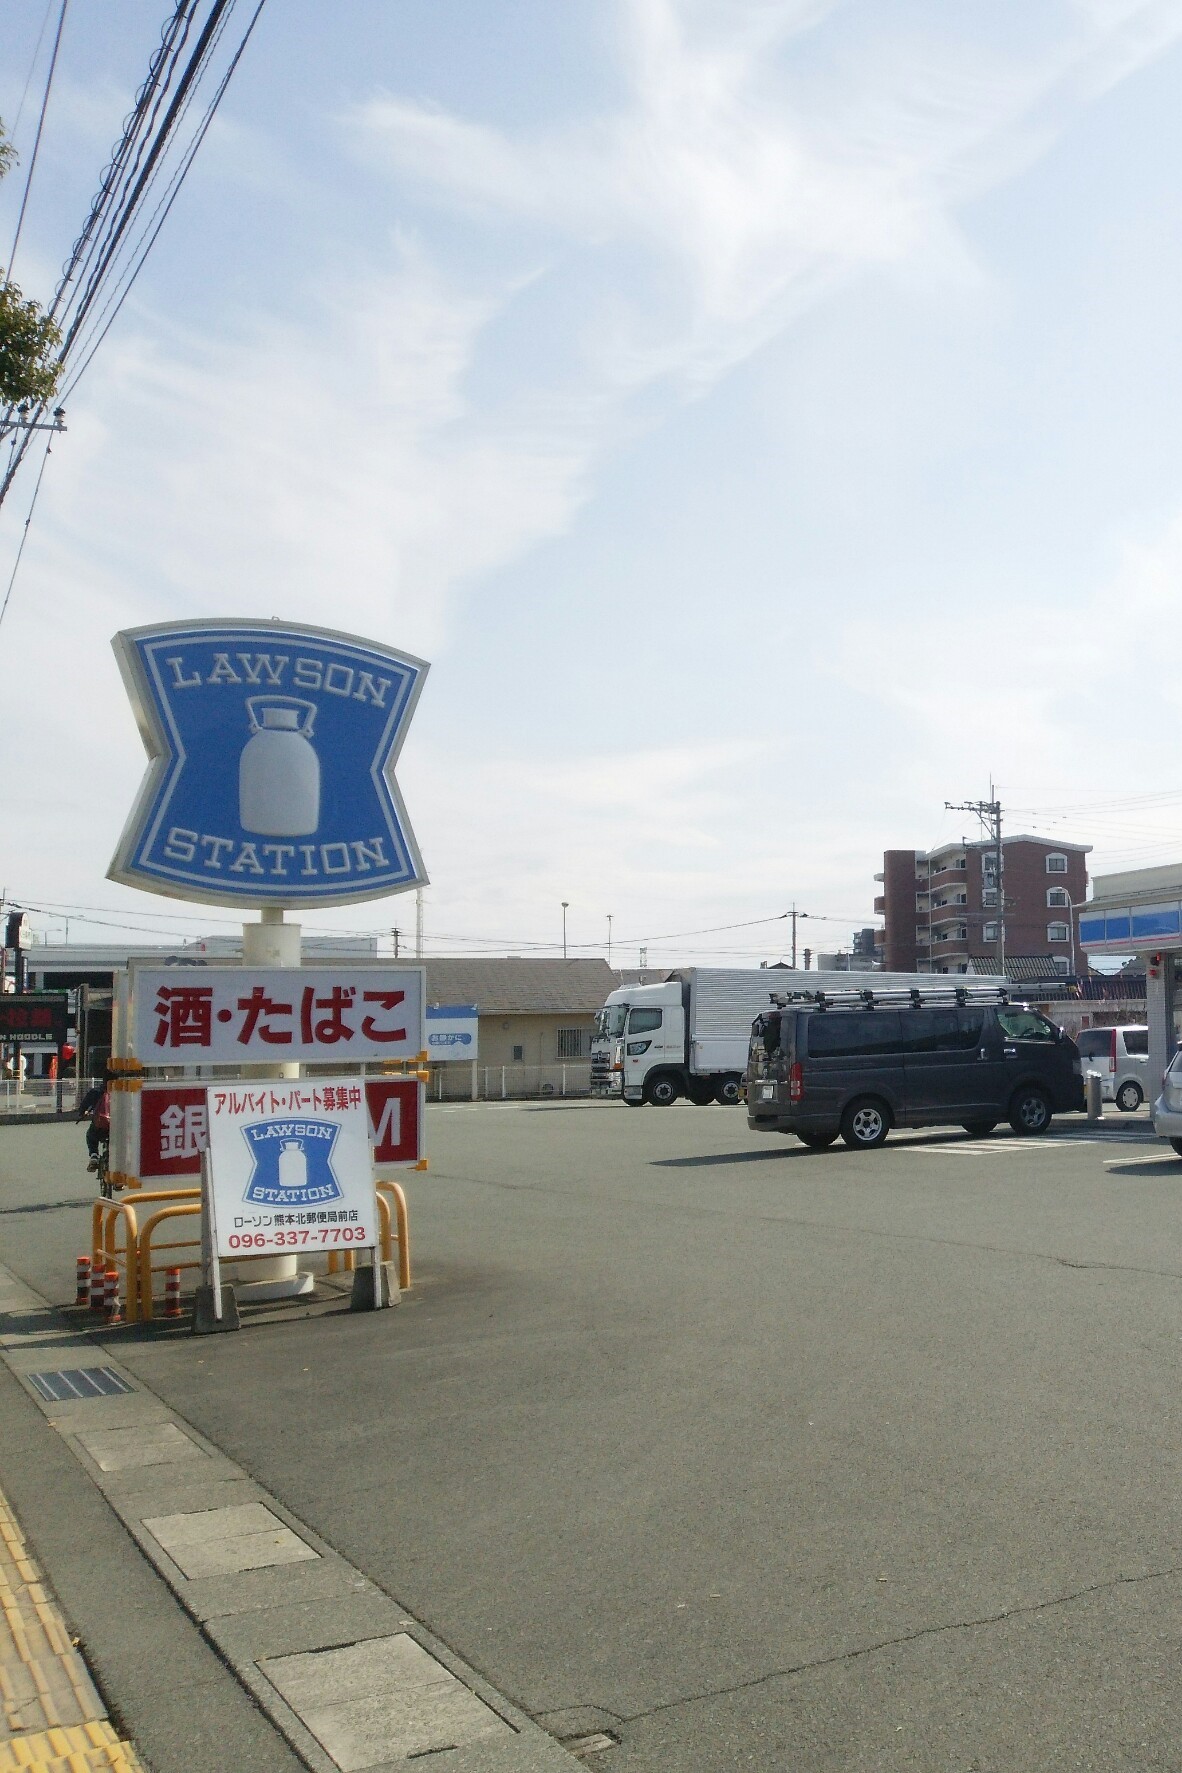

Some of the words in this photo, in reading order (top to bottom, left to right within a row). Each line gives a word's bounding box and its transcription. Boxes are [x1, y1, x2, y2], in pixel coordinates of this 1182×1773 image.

[165, 652, 392, 708] LAWSON
[163, 826, 391, 876] STATION
[153, 985, 407, 1048] 酒・たばこ
[214, 1085, 361, 1115] アルバイト・パート募集中
[251, 1124, 333, 1141] LAWSON
[252, 1184, 335, 1202] STATION
[228, 1226, 366, 1249] 096-337-7703
